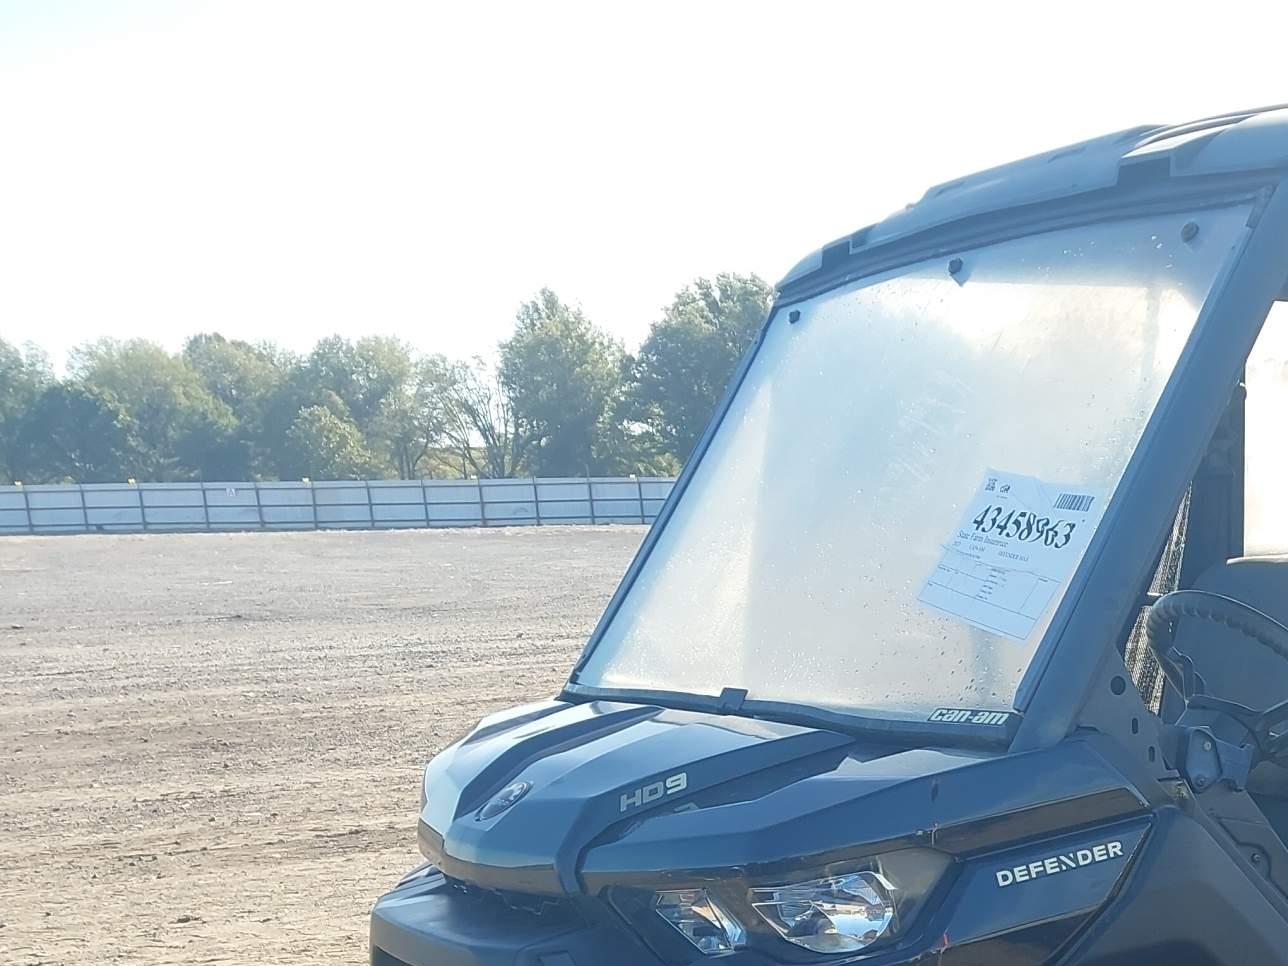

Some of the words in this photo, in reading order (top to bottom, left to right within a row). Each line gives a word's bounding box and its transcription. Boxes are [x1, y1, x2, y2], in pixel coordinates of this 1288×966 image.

[973, 505, 1076, 549] 43458963
[930, 709, 1010, 725] can-am
[620, 772, 687, 812] HD9
[996, 841, 1123, 887] DEFENDER
